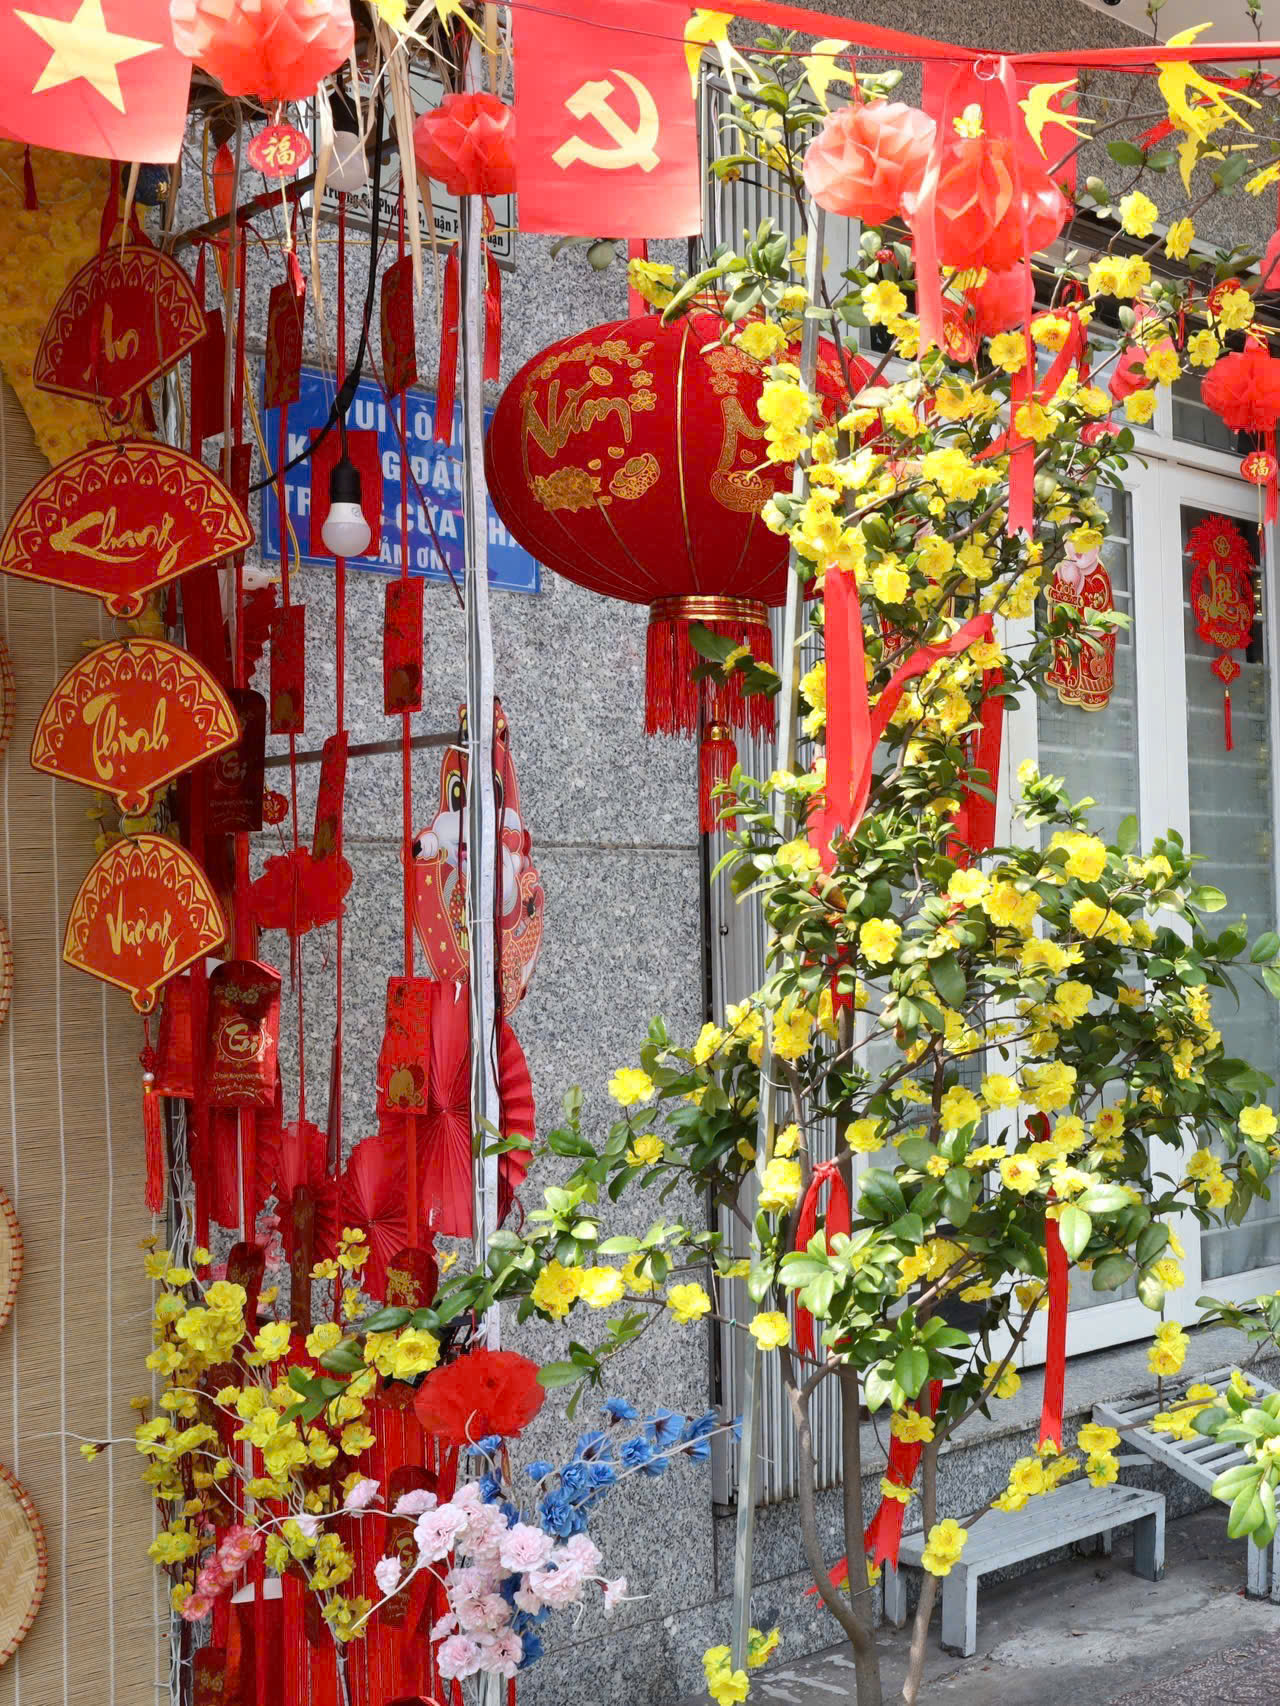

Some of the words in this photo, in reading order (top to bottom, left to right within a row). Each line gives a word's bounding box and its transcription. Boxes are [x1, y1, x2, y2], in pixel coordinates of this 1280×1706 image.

[261, 134, 296, 168] 福
[433, 215, 452, 233] uận
[1249, 457, 1270, 477] 福
[49, 506, 192, 577] Khang
[82, 692, 169, 781] Thịnh
[106, 890, 185, 973] Vượng
